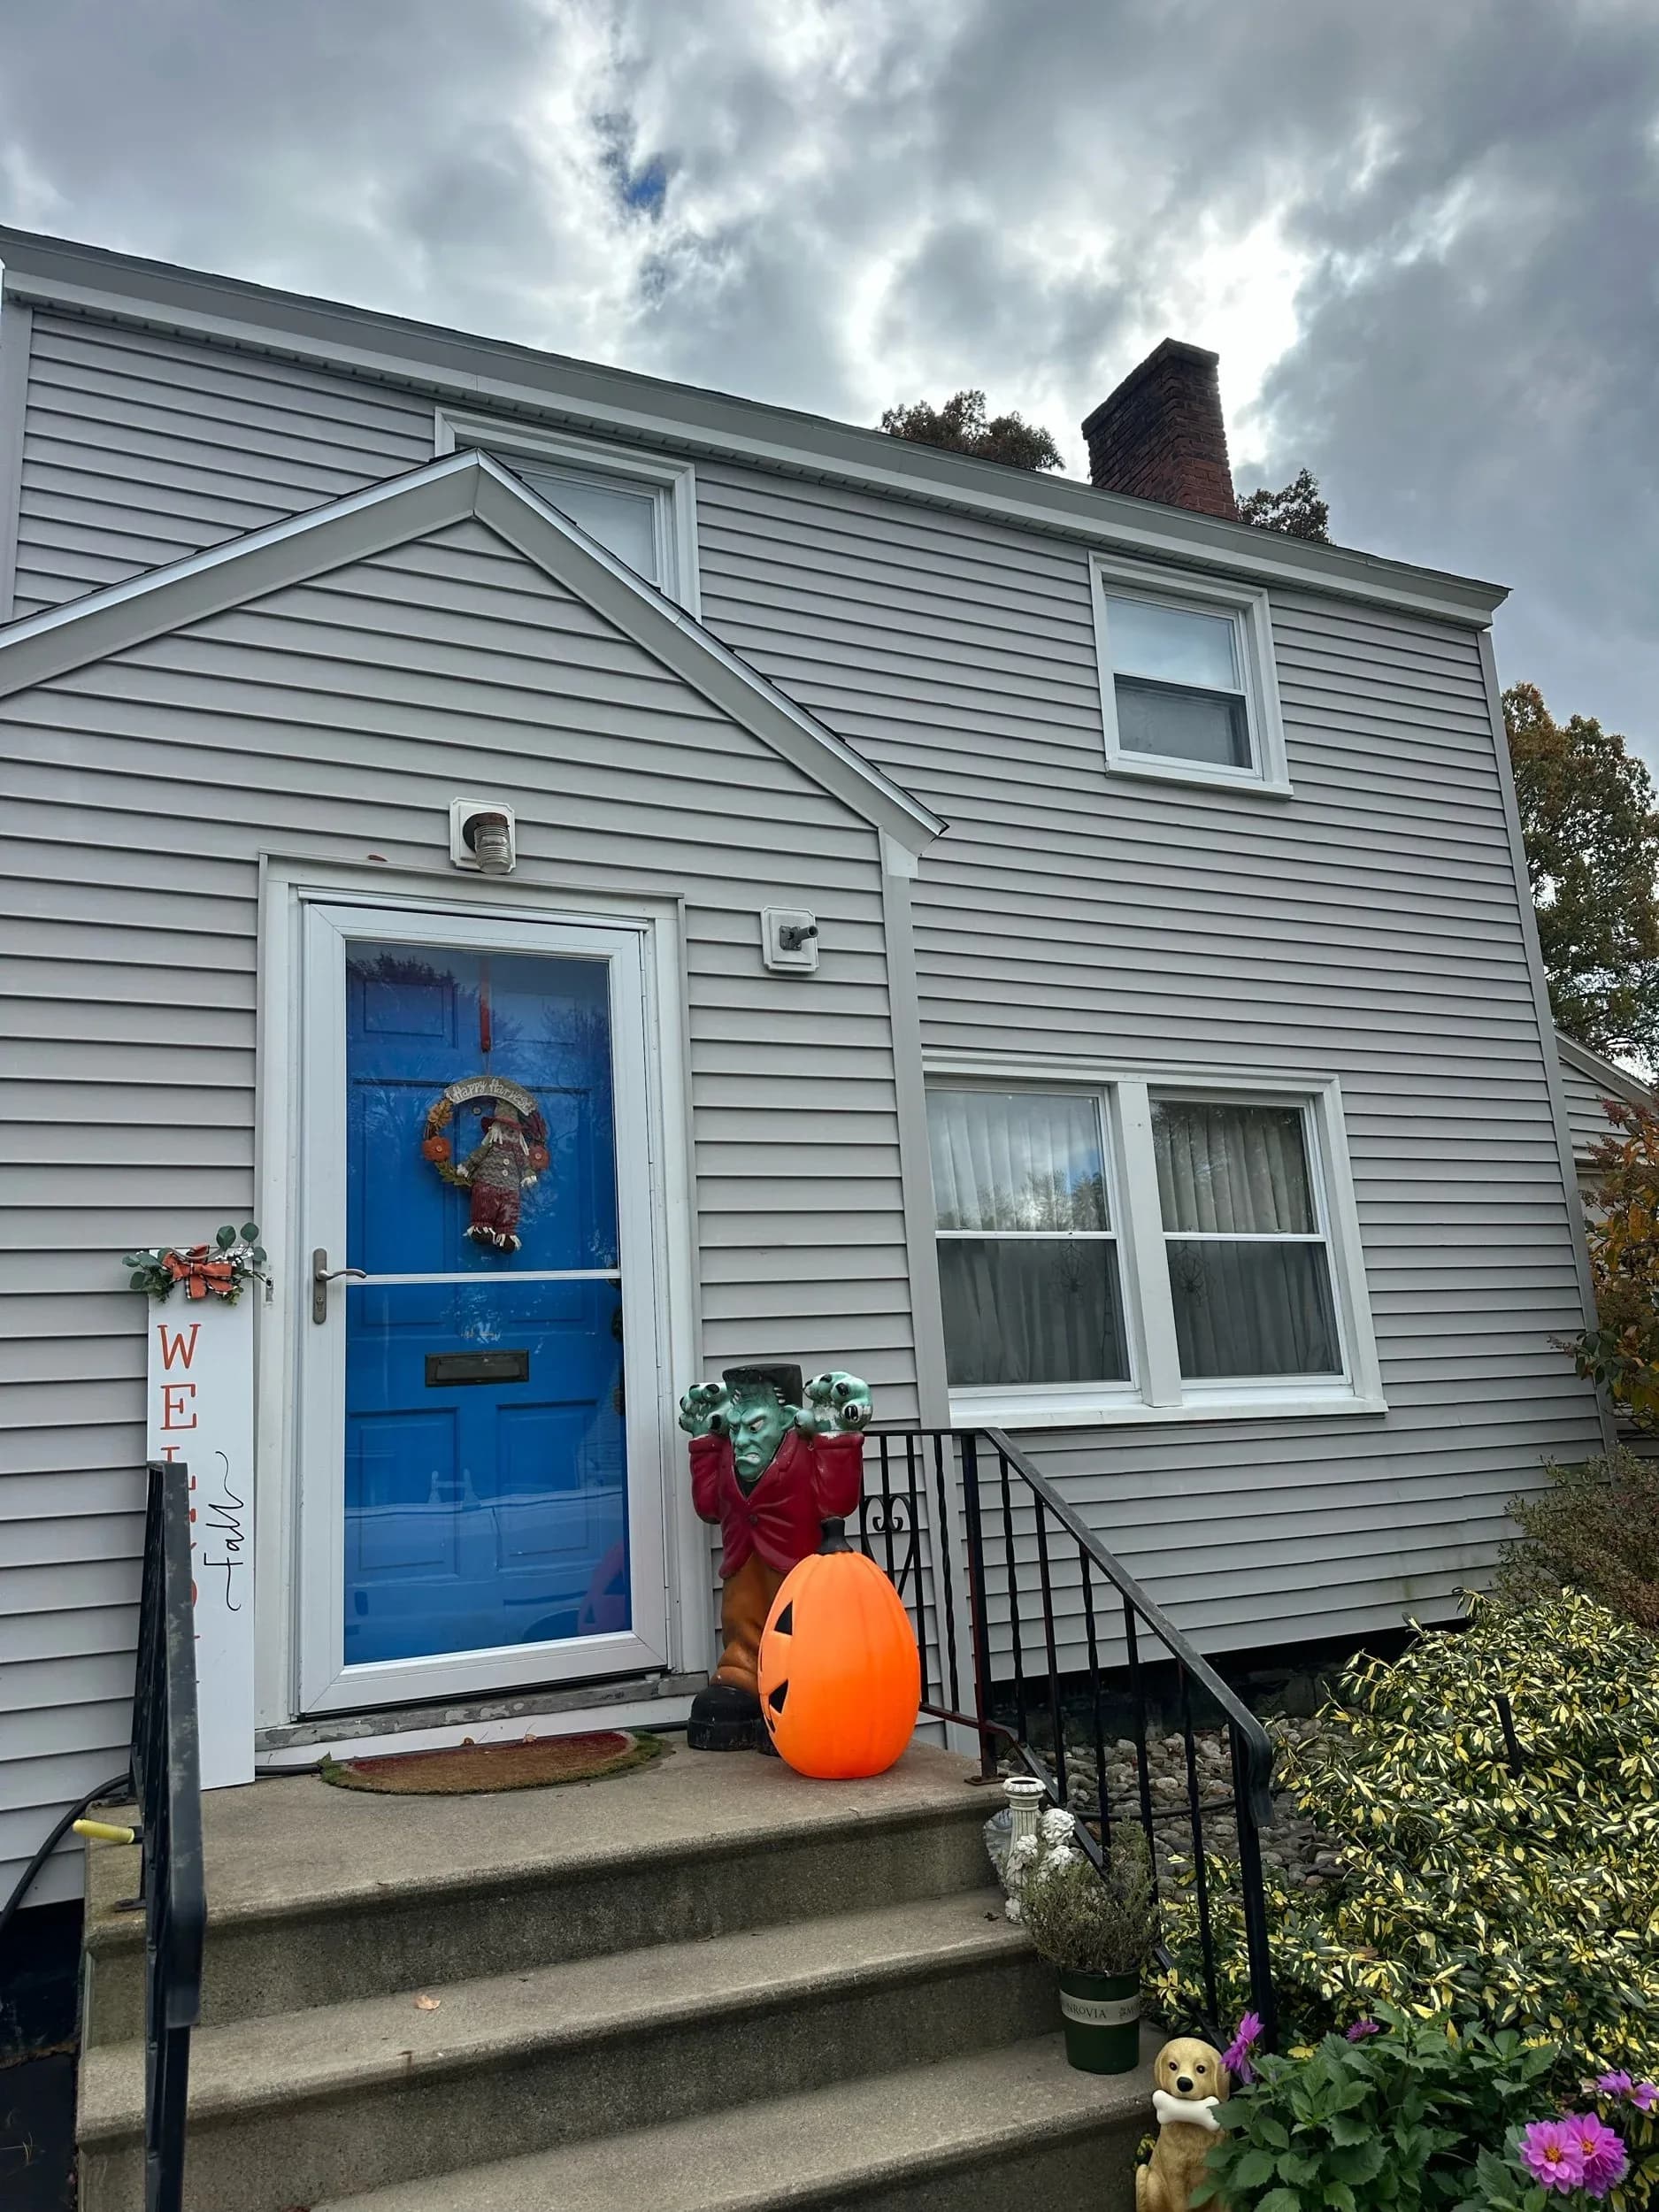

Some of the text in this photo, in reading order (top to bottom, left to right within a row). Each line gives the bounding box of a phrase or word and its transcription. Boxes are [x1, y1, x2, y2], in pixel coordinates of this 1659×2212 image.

[452, 1079, 532, 1110] Happy Harvest
[204, 1450, 245, 1611] Fall
[1066, 2002, 1107, 2018] NROVIA
